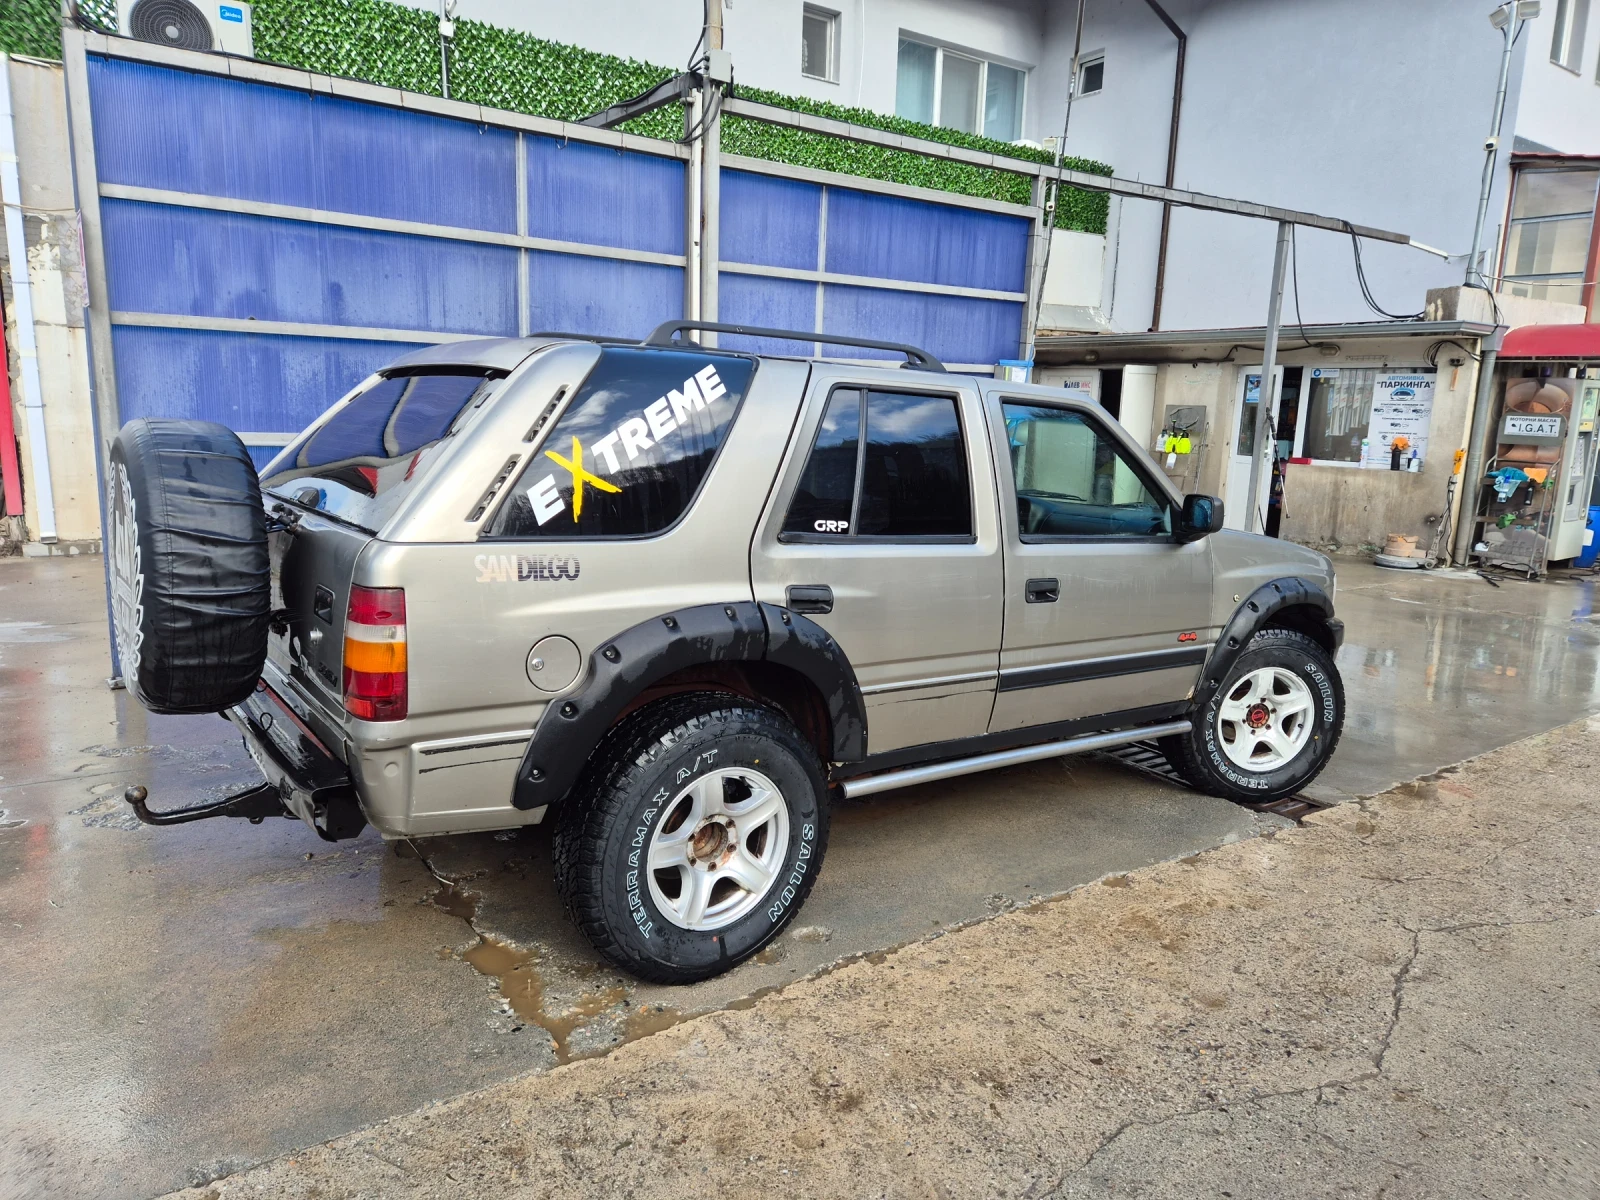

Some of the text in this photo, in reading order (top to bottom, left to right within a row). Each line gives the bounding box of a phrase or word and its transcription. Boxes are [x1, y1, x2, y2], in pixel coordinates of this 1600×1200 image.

[1376, 381, 1435, 389] "ПАРКИНГА"
[526, 363, 727, 526] EXTREME
[1518, 423, 1557, 434] I.G.A.T.
[814, 519, 849, 532] GRP
[1304, 662, 1334, 722] SAILUN
[1205, 729, 1269, 789] TERRAMAX
[626, 749, 718, 938] TERRAMAX A/T
[768, 824, 815, 922] SAILUN
